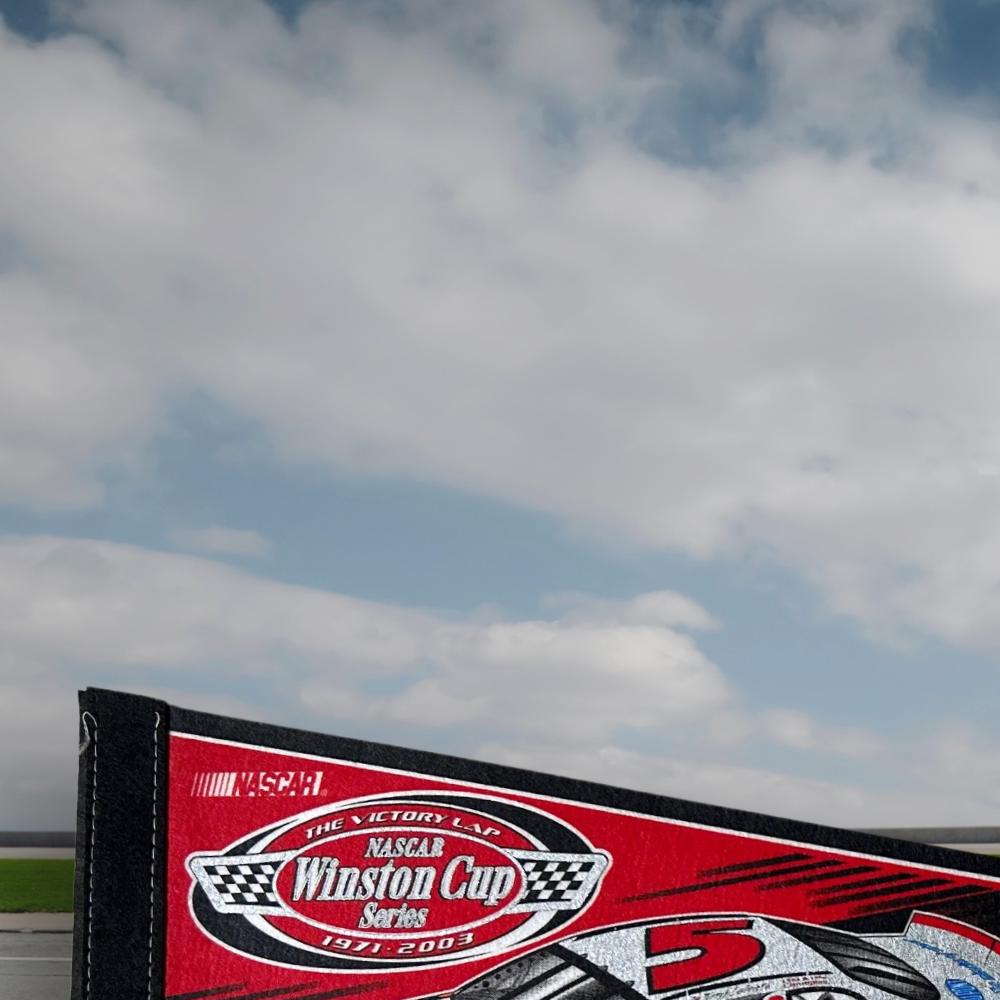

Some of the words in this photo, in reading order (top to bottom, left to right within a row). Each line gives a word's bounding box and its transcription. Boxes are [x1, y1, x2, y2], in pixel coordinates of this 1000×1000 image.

[234, 771, 323, 797] NASCAR
[305, 817, 344, 840] THE
[351, 810, 449, 826] VICTORY
[452, 817, 502, 837] LAP
[364, 836, 446, 860] NASCAR
[291, 855, 438, 902] Winston
[439, 855, 517, 907] Cup
[357, 902, 430, 929] Series
[321, 935, 382, 954] 1971
[398, 932, 475, 954] 2003
[644, 918, 767, 995] 5
